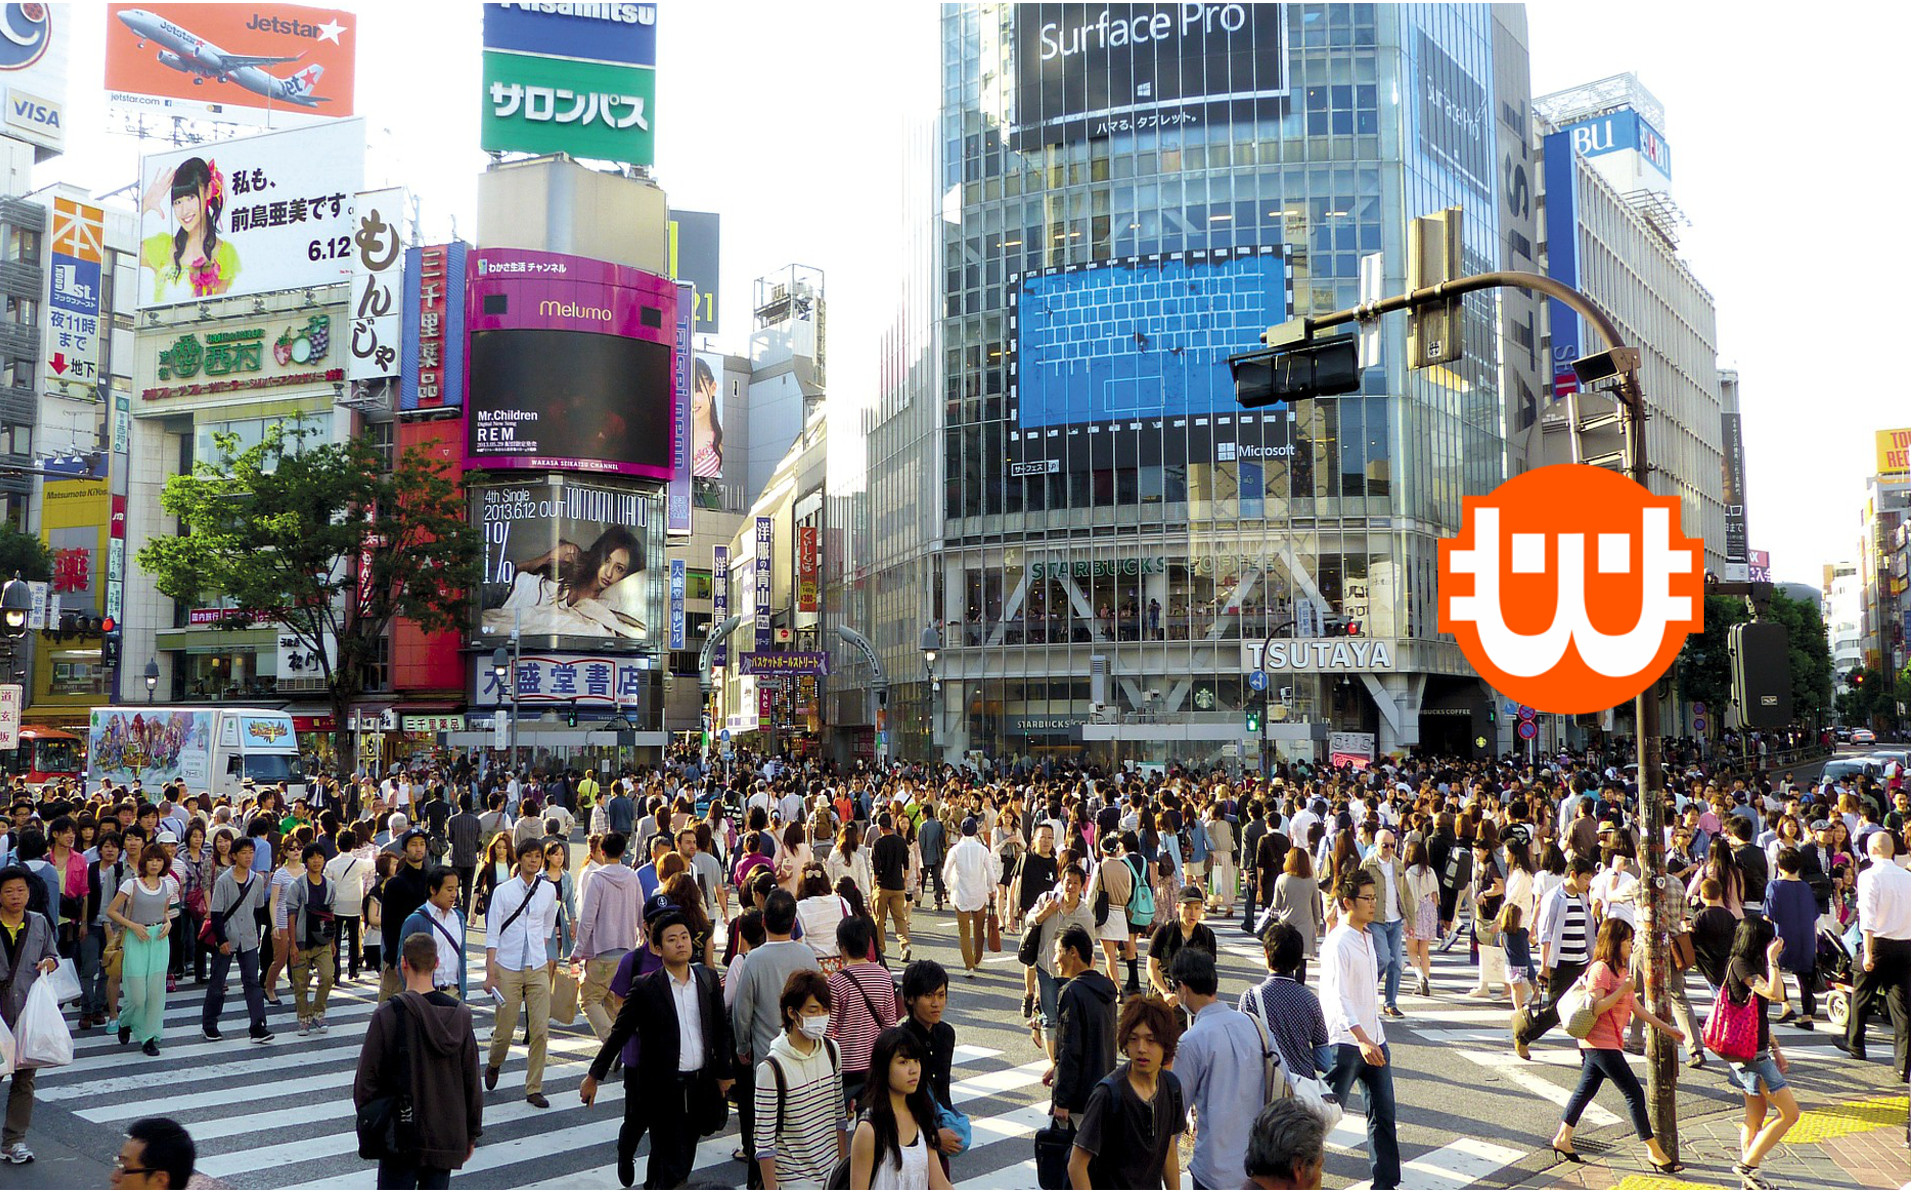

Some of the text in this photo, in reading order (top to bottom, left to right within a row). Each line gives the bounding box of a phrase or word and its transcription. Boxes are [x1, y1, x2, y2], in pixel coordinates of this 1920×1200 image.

[159, 20, 197, 46] Jetstar
[246, 13, 319, 39] Jetstar
[1041, 3, 1245, 60] Surface Pro
[110, 92, 161, 107] jetstar.com
[489, 80, 648, 131] サロンパス
[13, 97, 61, 129] VISA
[1096, 112, 1197, 134] ハマる、タブレット。
[231, 169, 277, 196] 私も、
[308, 236, 351, 262] 6.12
[54, 264, 65, 291] BOOK
[488, 261, 567, 273] わかさ生活 チャンネル
[350, 207, 401, 373] もんじゃ
[50, 310, 97, 336] 夜11時
[417, 250, 443, 399] 三千里薬品
[59, 332, 88, 351] まで
[70, 358, 96, 378] 地下
[477, 409, 539, 421] Mr.Children
[1238, 443, 1296, 458] Microsoft
[531, 459, 559, 467] WAKASA
[590, 462, 619, 471] CHANNEL
[46, 490, 87, 500] Matsumoto
[485, 487, 530, 504] 4th Single
[484, 500, 566, 521] 2013.6.12 OUT
[756, 520, 771, 607] 洋服の青山
[1031, 556, 1168, 580] STARBUCKS
[752, 655, 819, 669] バスケットボールストリート
[1246, 641, 1391, 670] TSUTAYA
[483, 662, 641, 697] 大盛堂書店
[1017, 719, 1070, 729] STARBUCKS
